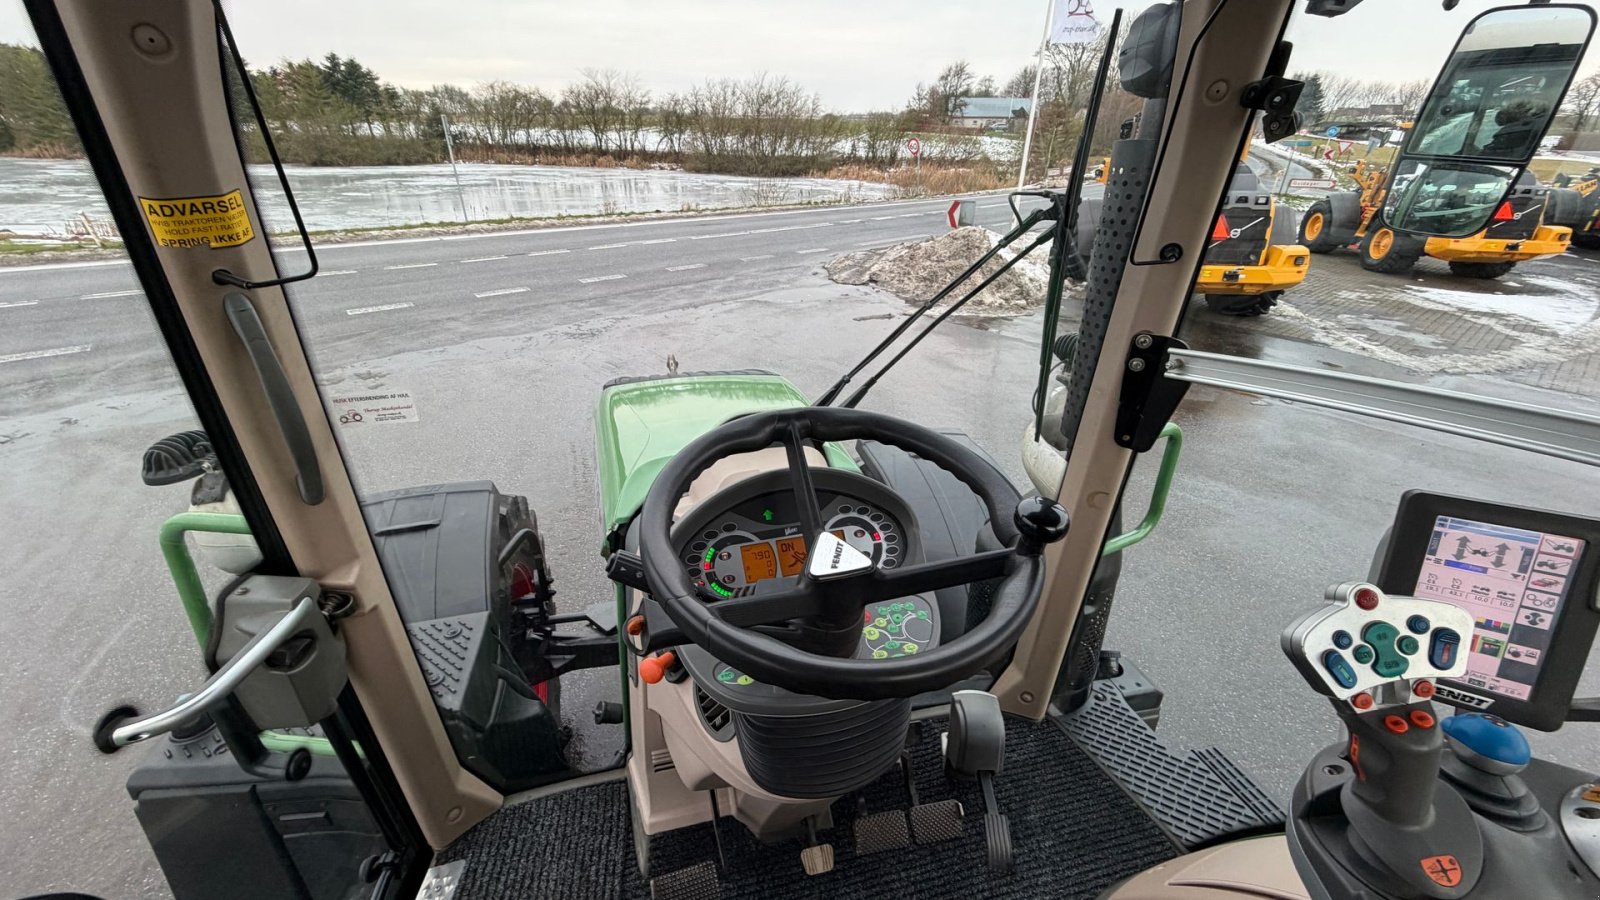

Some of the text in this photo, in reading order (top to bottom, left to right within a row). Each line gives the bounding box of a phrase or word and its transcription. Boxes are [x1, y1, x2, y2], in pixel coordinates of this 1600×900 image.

[148, 195, 242, 217] ADVARSEL
[164, 228, 190, 236] HOLD
[191, 225, 213, 234] FAST
[172, 216, 226, 227] TRAKTOREN
[160, 227, 250, 249] SPRING IKKE AF
[752, 550, 770, 561] 790
[831, 541, 845, 569] FENDT
[1436, 687, 1490, 706] ENDT
